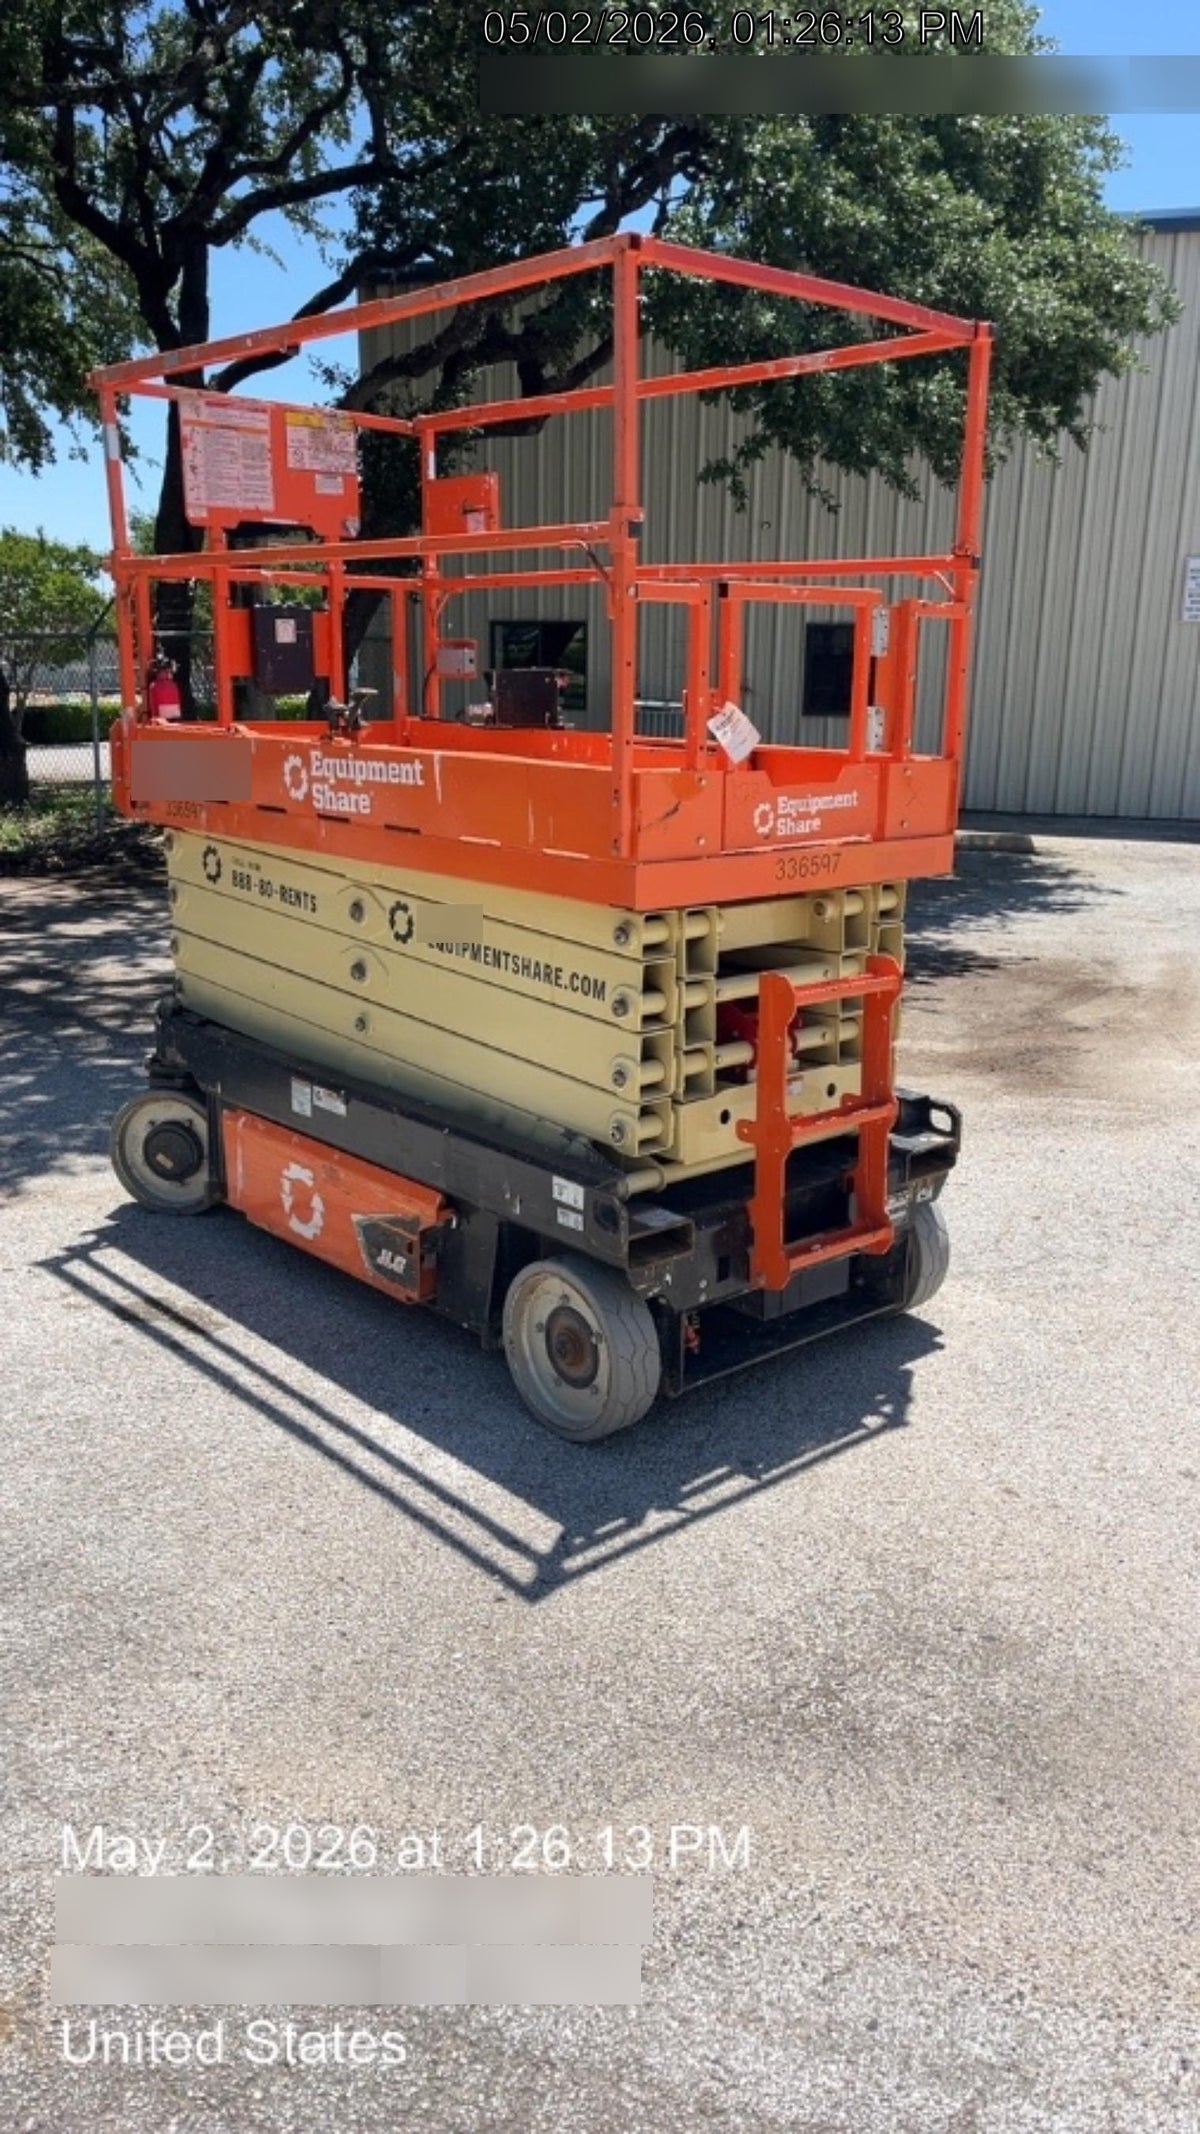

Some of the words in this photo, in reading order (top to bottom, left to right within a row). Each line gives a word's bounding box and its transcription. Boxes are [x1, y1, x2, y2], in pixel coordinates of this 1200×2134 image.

[310, 751, 425, 786] Equipment
[311, 785, 371, 814] Share
[776, 789, 859, 817] Equipment
[776, 816, 822, 836] Share
[774, 852, 842, 881] 336597
[231, 869, 317, 914] 888-80-RENTS
[427, 942, 606, 1002] UIPMENTSHARE.COM
